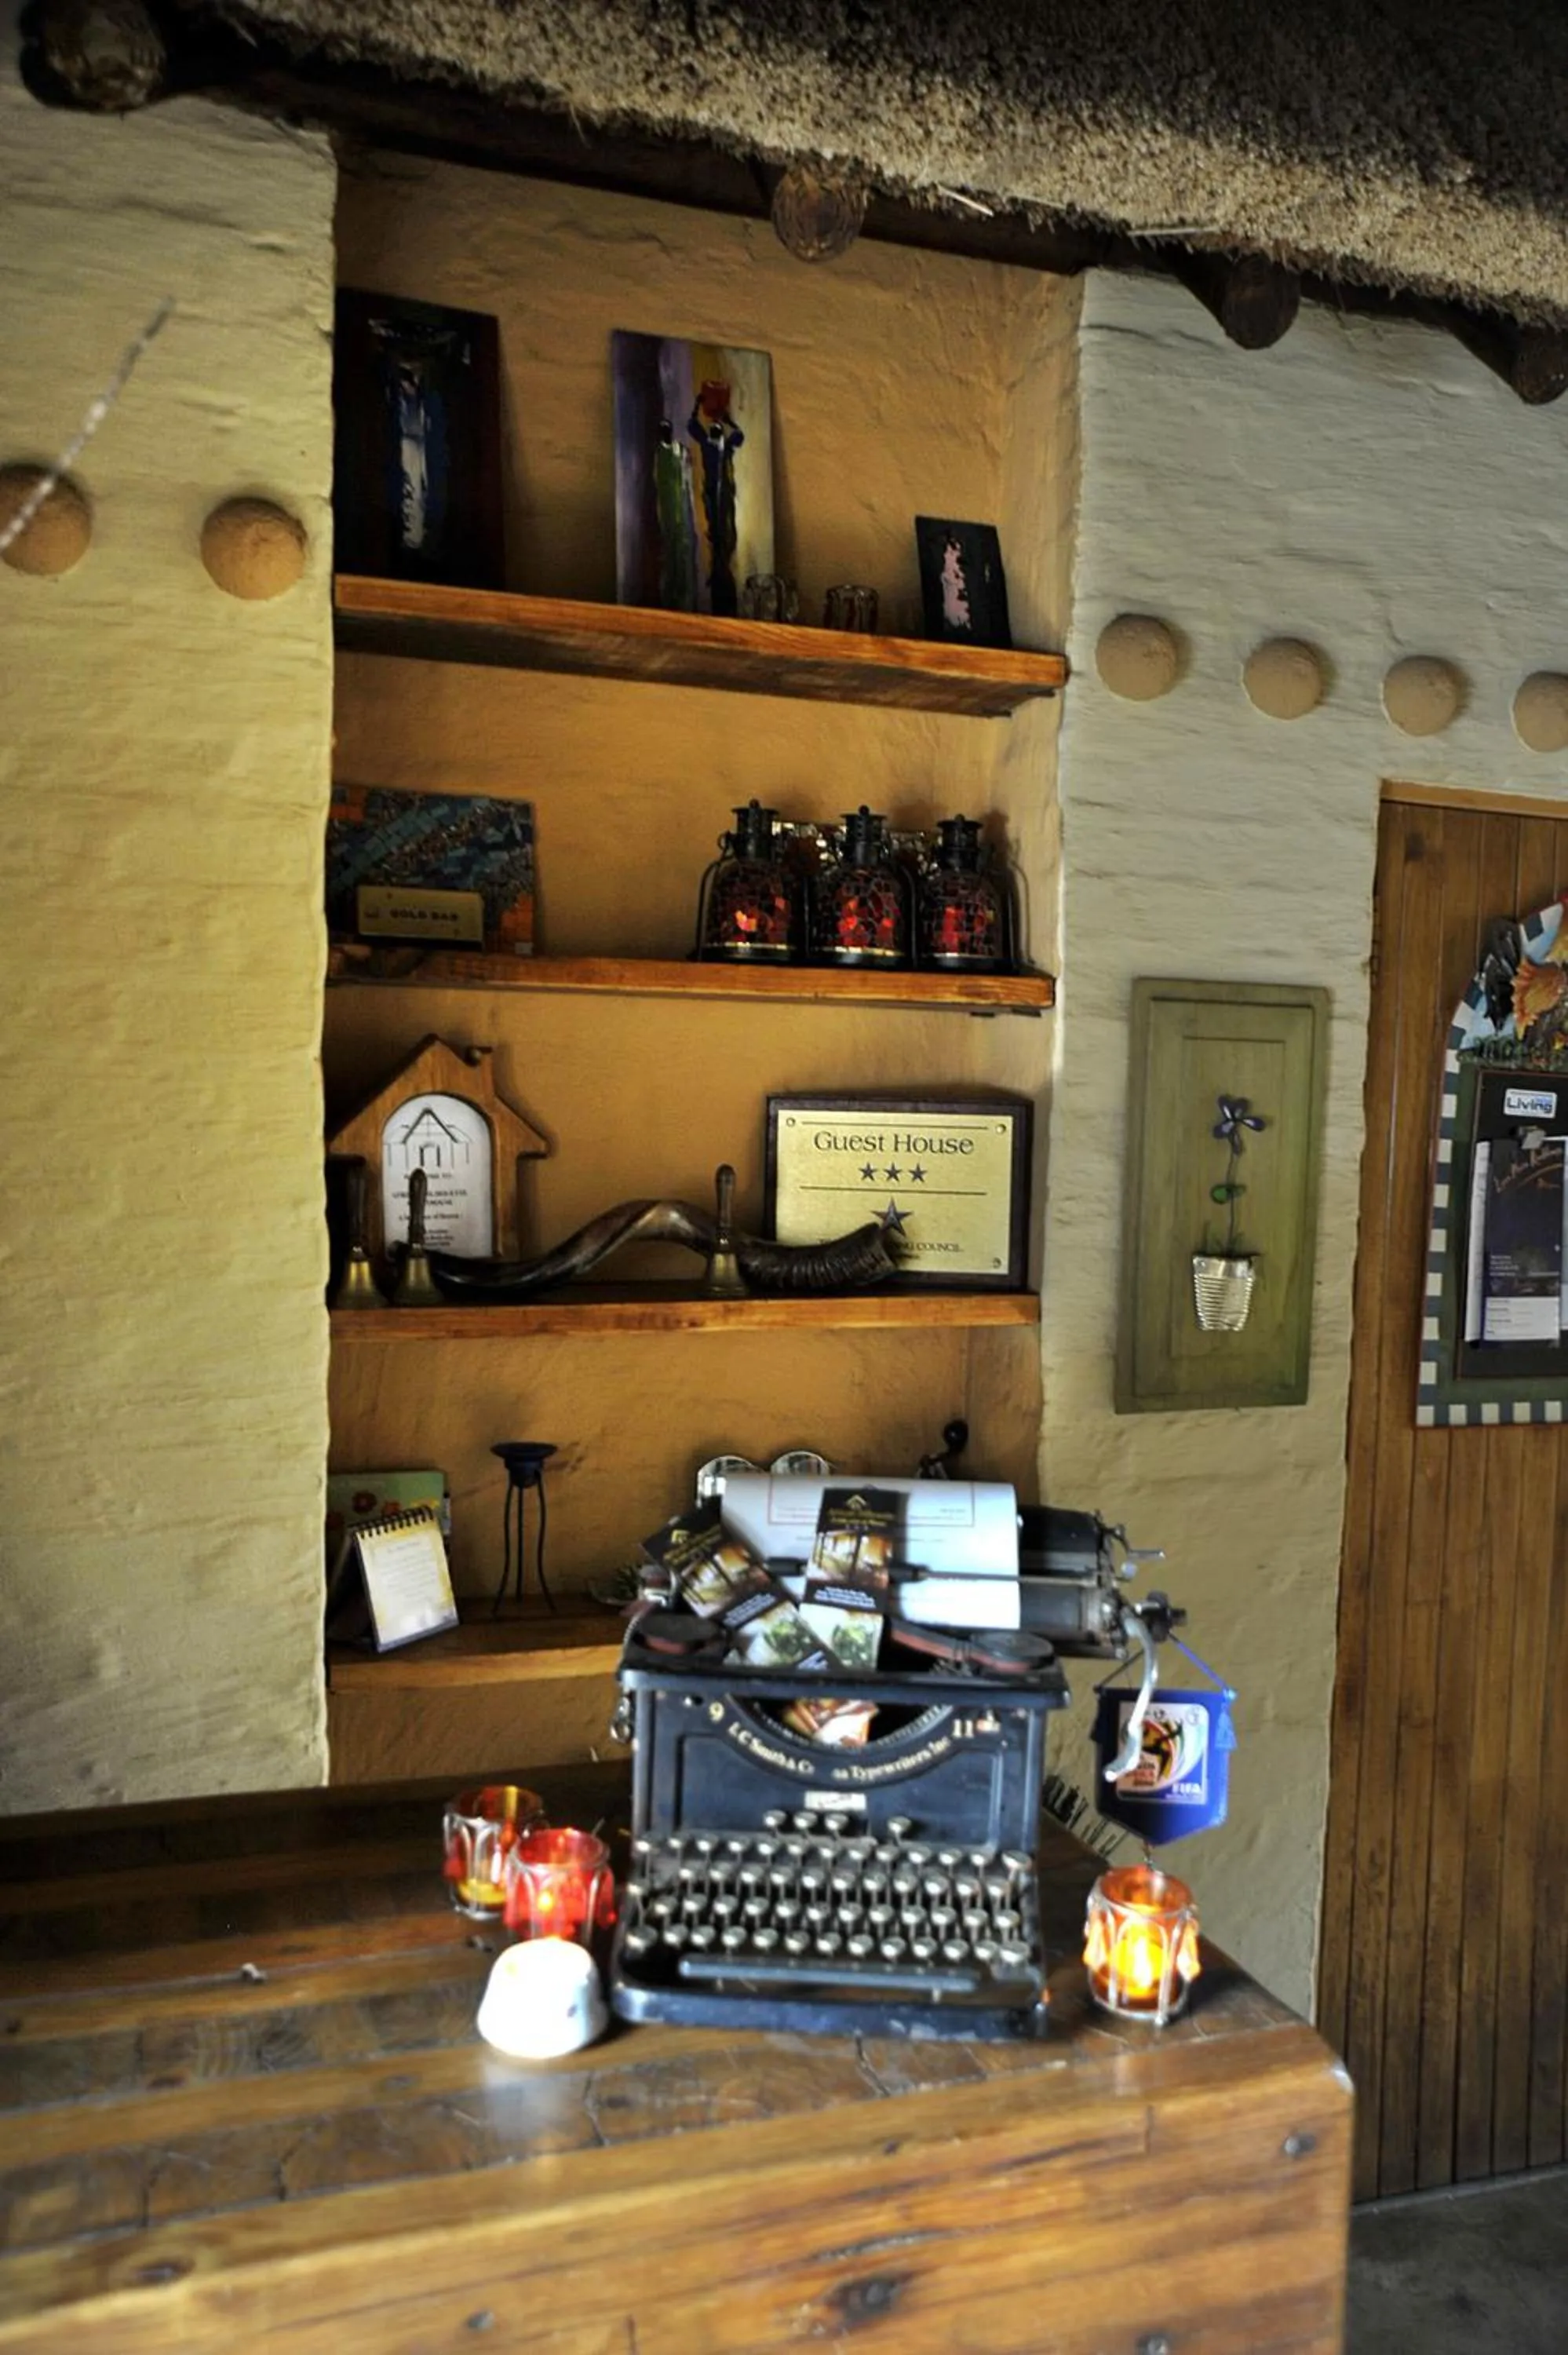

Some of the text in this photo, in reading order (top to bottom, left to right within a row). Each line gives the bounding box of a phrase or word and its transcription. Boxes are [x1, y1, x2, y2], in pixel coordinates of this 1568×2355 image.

[1507, 1097, 1553, 1114] Living
[814, 1131, 975, 1155] Guest House
[850, 1749, 932, 1784] Typewriters
